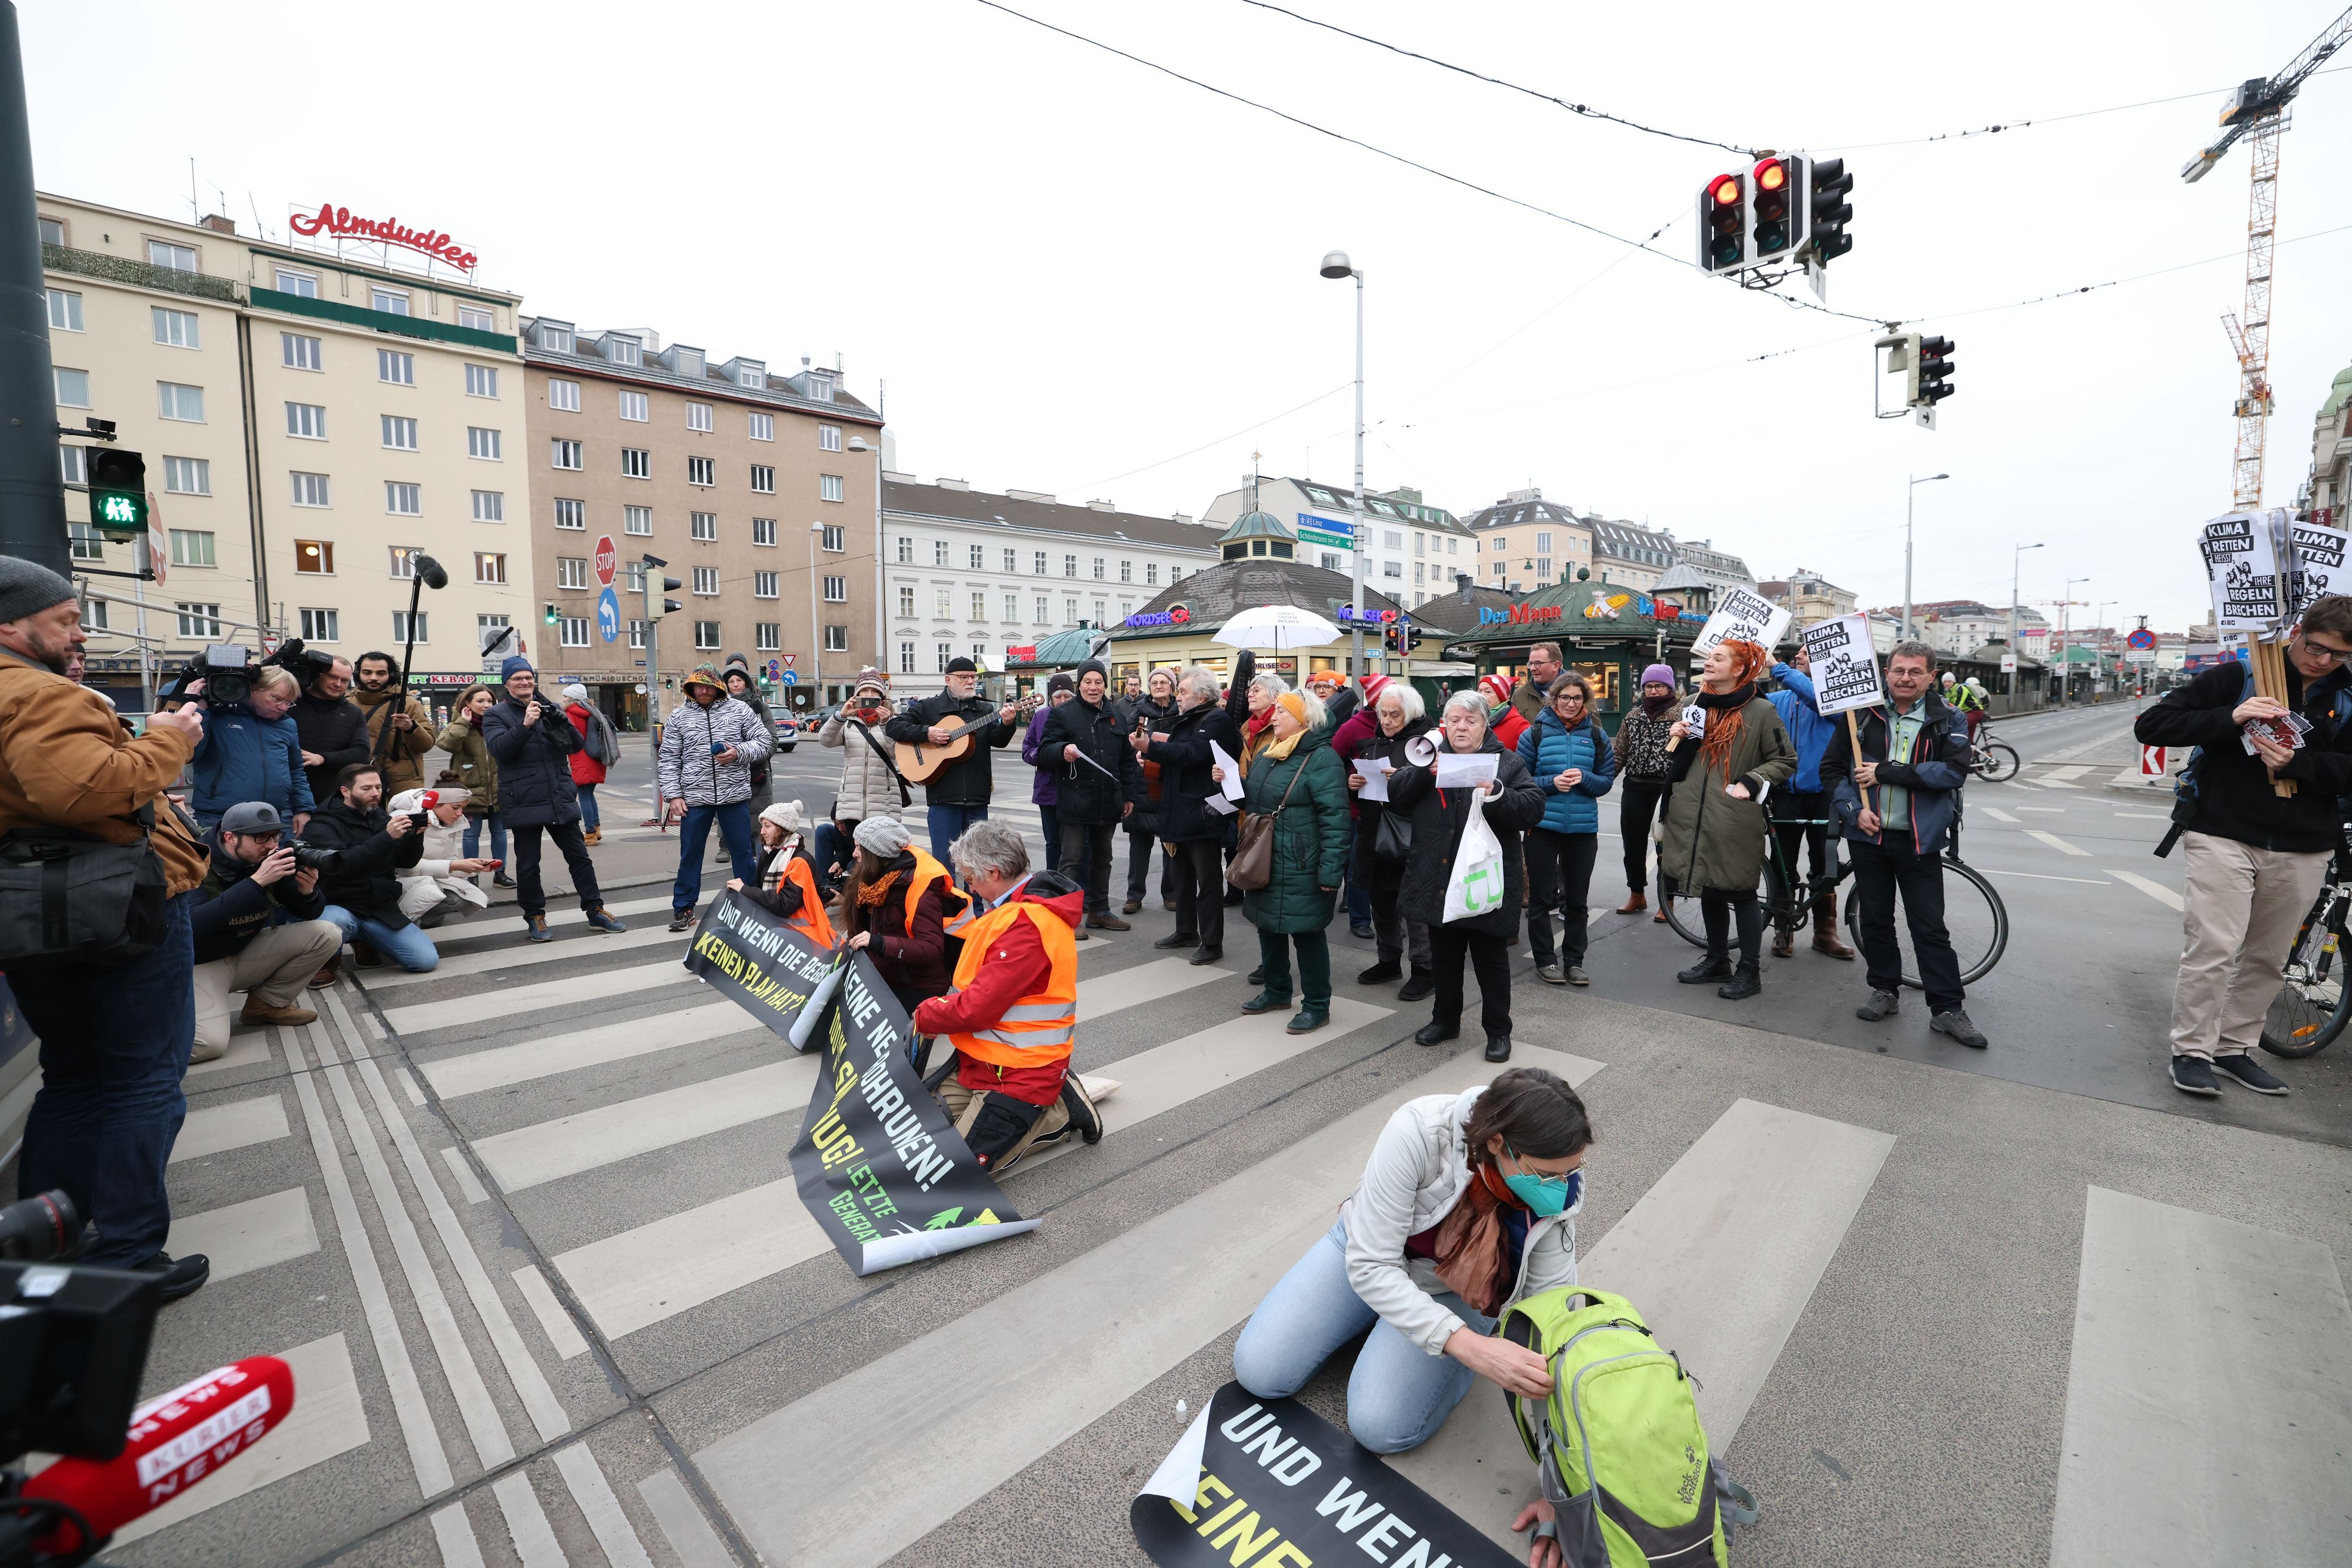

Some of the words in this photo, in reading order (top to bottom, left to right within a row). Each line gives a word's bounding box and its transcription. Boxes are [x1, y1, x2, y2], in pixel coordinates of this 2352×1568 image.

[290, 203, 477, 268] Almdudler
[1299, 531, 1327, 543] Schönbrunn
[2208, 523, 2245, 537] KLIMA
[2293, 529, 2337, 549] LIMA
[2212, 538, 2250, 552] RETTEN
[597, 551, 614, 571] STOP
[2214, 554, 2231, 563] HEISST
[2297, 547, 2340, 566] TTEN
[2254, 577, 2272, 586] IHRE
[1736, 591, 1769, 615] KLIMA
[2229, 588, 2273, 601] REGELN
[1126, 611, 1171, 627] NORDSEE
[1338, 607, 1381, 622] NOSEE
[1727, 607, 1746, 620] HEISST
[1731, 601, 1768, 626] RETTEN
[2225, 604, 2275, 616] BRECHEN
[1807, 624, 1840, 642] KLIMA
[1809, 634, 1847, 654] RETTEN
[1810, 651, 1829, 662] HEISST
[1853, 661, 1870, 670] IHRE
[1827, 670, 1872, 688] REGELN
[1822, 681, 1875, 702] BRECHEN
[717, 898, 741, 930] UND
[737, 916, 784, 957] WENN
[777, 944, 807, 971] DIE
[694, 931, 745, 980] KEINEN
[739, 961, 780, 999] PLAN
[764, 988, 806, 1015] HAT?
[828, 1189, 883, 1245] GENERAT
[151, 1396, 262, 1475] KURIER
[149, 1417, 266, 1505] NEWS
[1220, 1403, 1322, 1486] UND
[1315, 1476, 1464, 1568] WEN
[1677, 1472, 1692, 1502] Jack
[1683, 1459, 1702, 1505] Wolfskin
[1169, 1465, 1313, 1568] EINE
